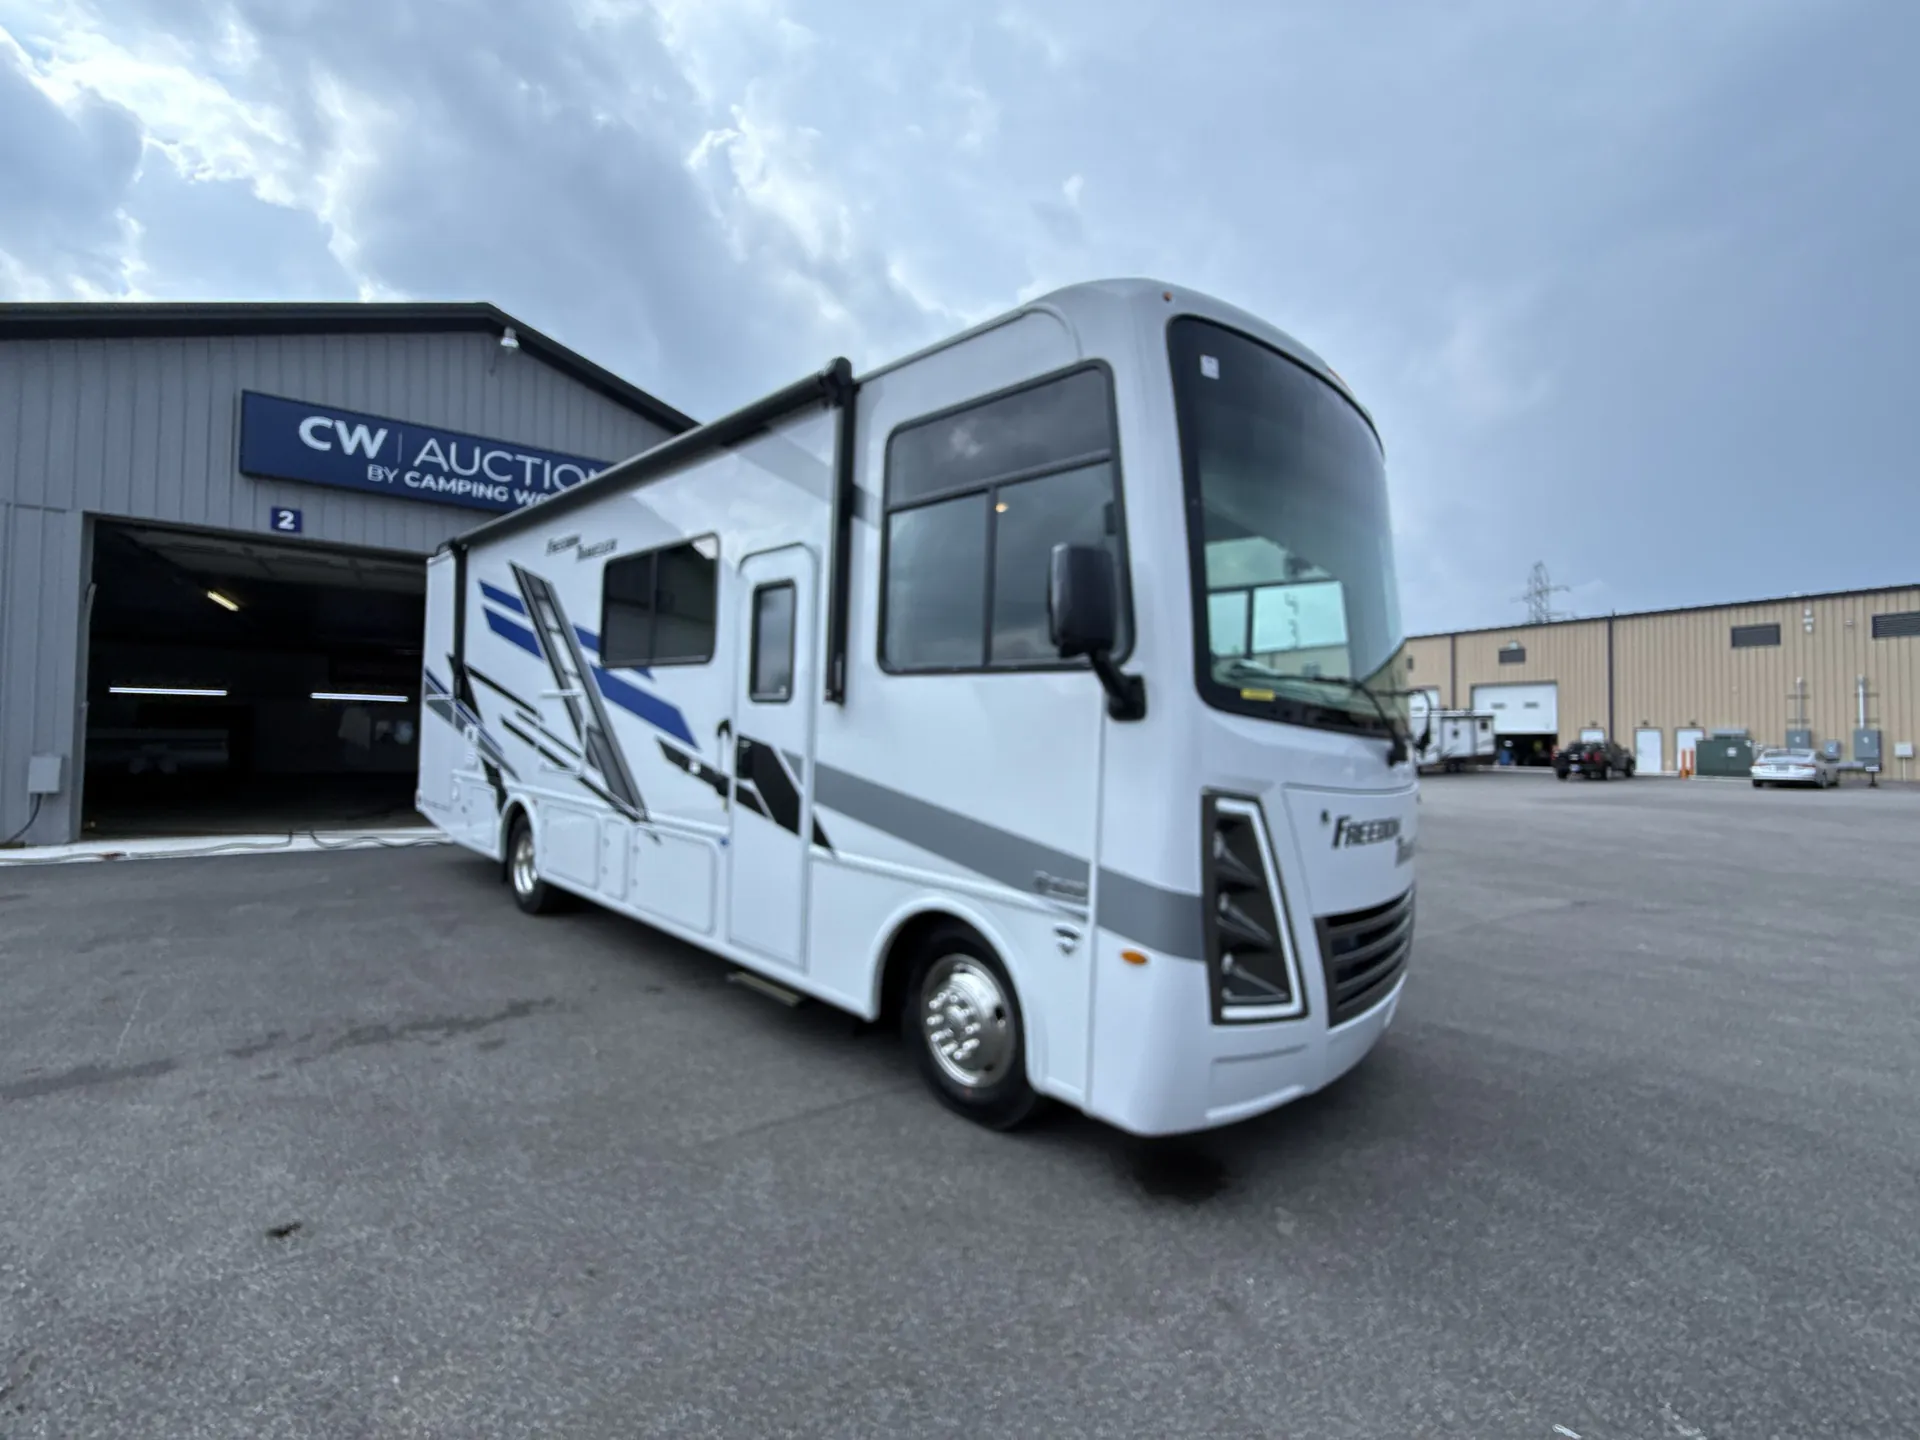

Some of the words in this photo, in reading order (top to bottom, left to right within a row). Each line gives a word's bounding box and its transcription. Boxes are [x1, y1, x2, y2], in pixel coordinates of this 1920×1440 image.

[298, 416, 388, 459] CW
[367, 464, 400, 484] BY
[404, 471, 509, 502] CAMPING
[278, 510, 295, 530] 2
